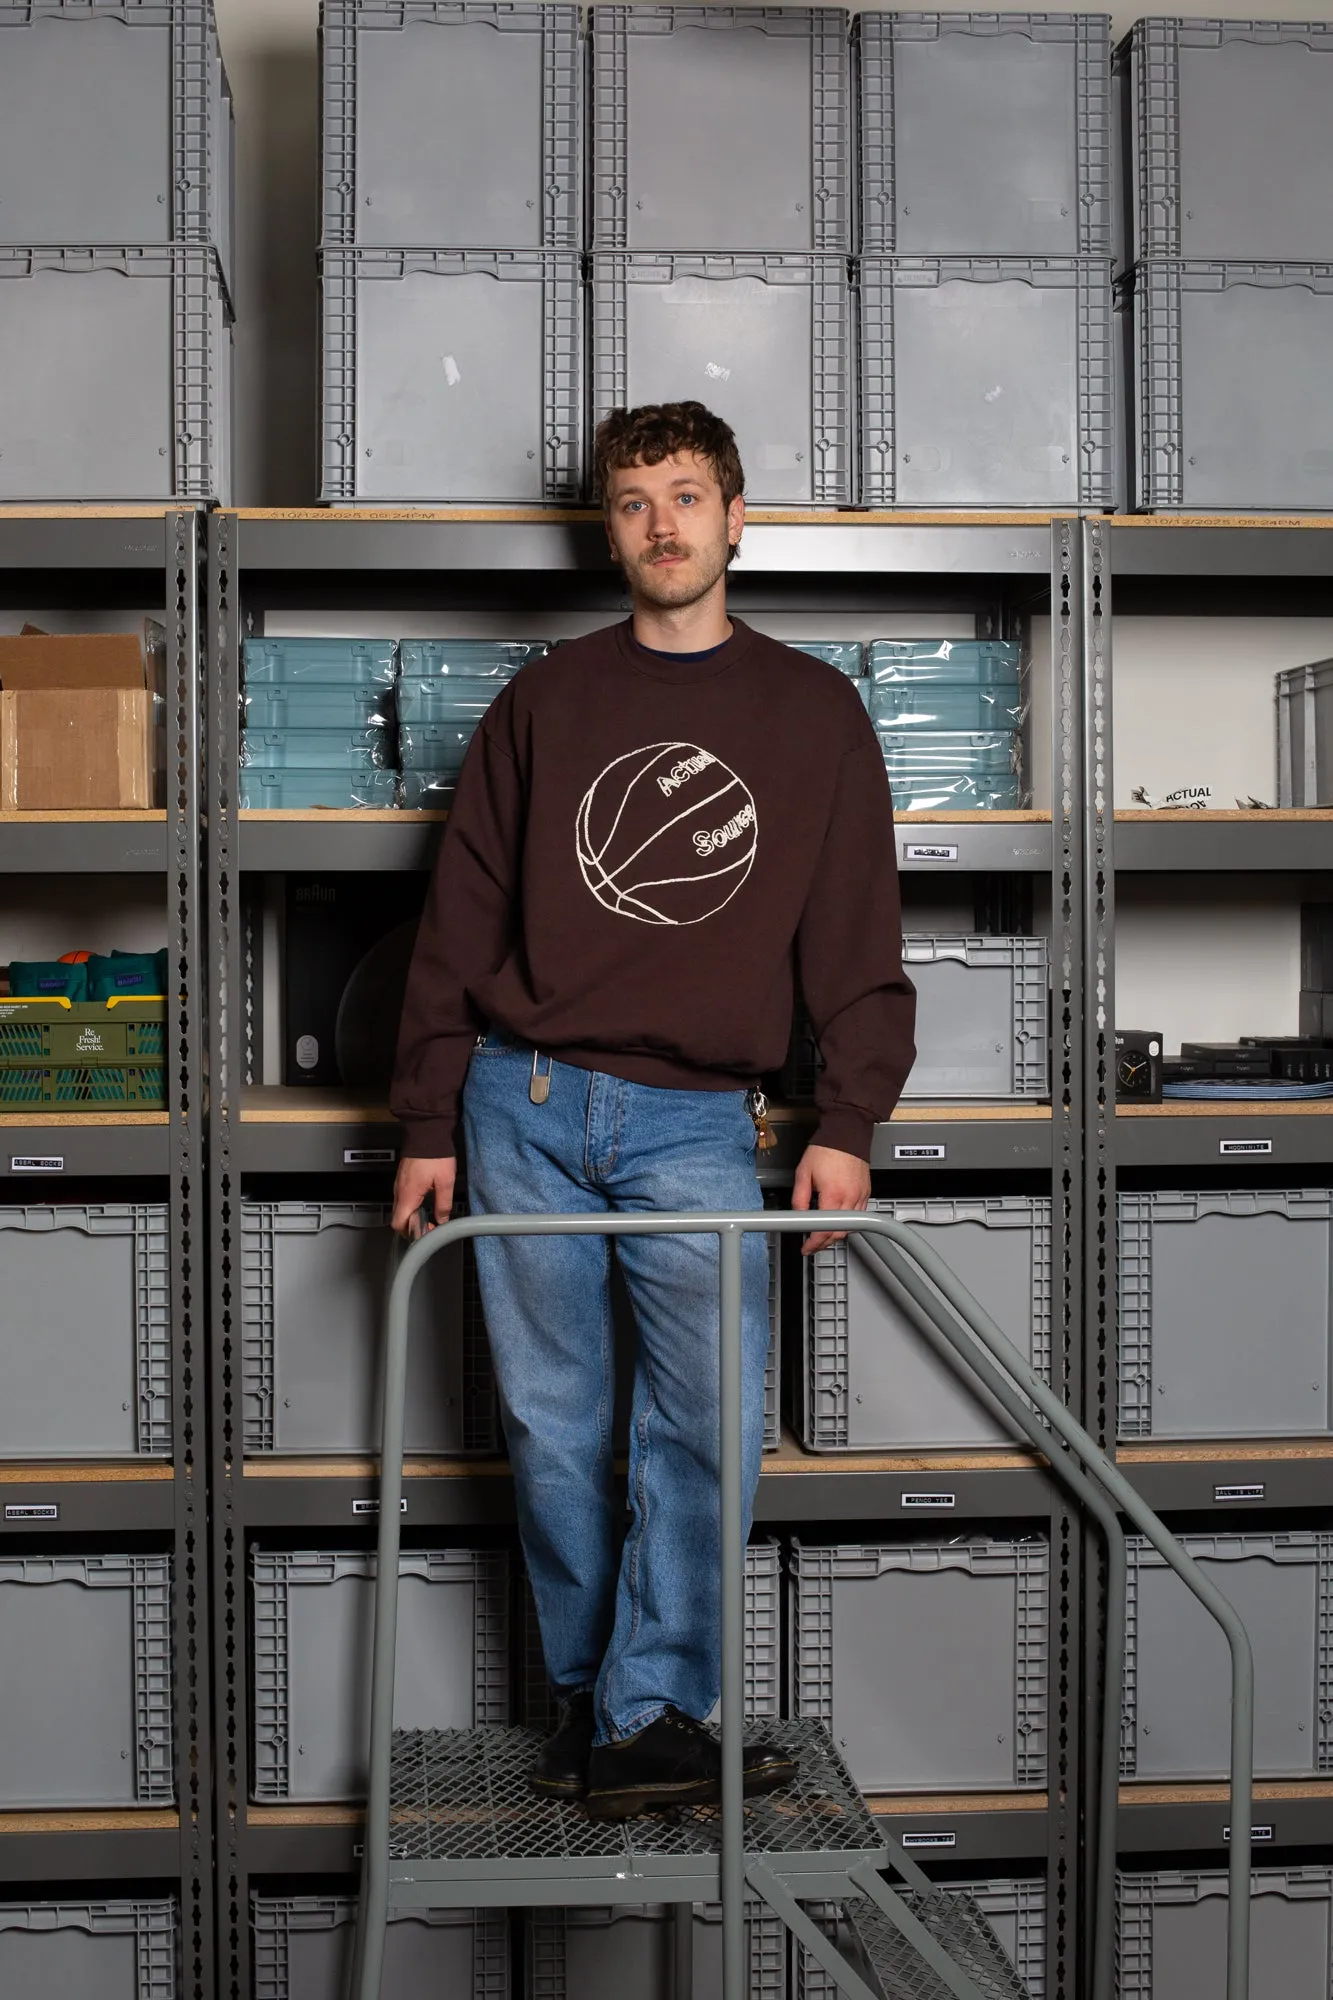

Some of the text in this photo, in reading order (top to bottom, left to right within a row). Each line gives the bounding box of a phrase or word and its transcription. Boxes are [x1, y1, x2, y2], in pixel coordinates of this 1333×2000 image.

[657, 751, 716, 797] Actual
[1165, 787, 1211, 802] ACTUAL
[692, 804, 754, 856] Source
[84, 1028, 94, 1036] Re
[79, 1035, 101, 1043] Fresh!
[76, 1043, 104, 1051] Service.
